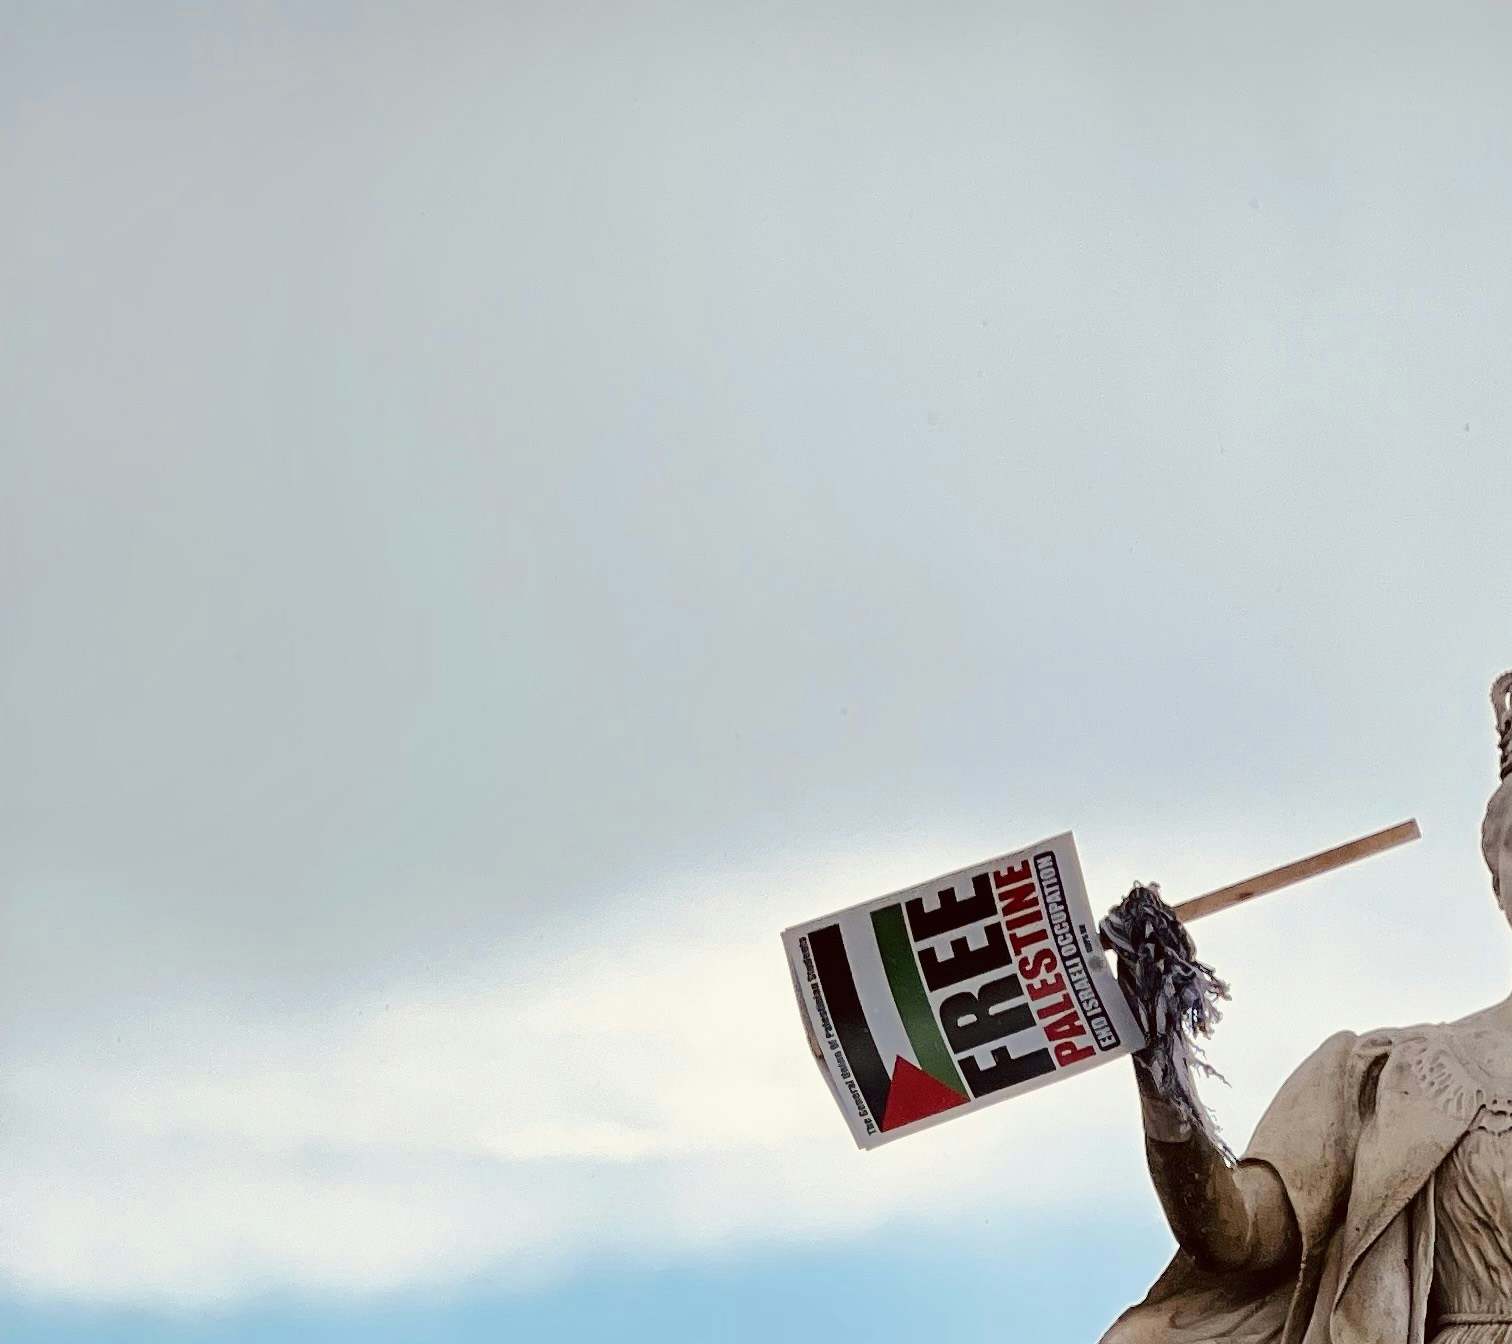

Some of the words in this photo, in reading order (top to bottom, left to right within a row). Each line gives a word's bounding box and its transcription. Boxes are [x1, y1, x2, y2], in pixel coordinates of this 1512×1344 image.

[1036, 855, 1077, 957] OCCUPATION
[905, 873, 1057, 1098] FREE
[993, 859, 1097, 1068] PALESTINE
[1065, 957, 1102, 1017] ISRAELI
[1091, 1016, 1117, 1048] END
[834, 1051, 851, 1079] Union
[845, 1080, 868, 1117] General
[863, 1118, 877, 1136] The
